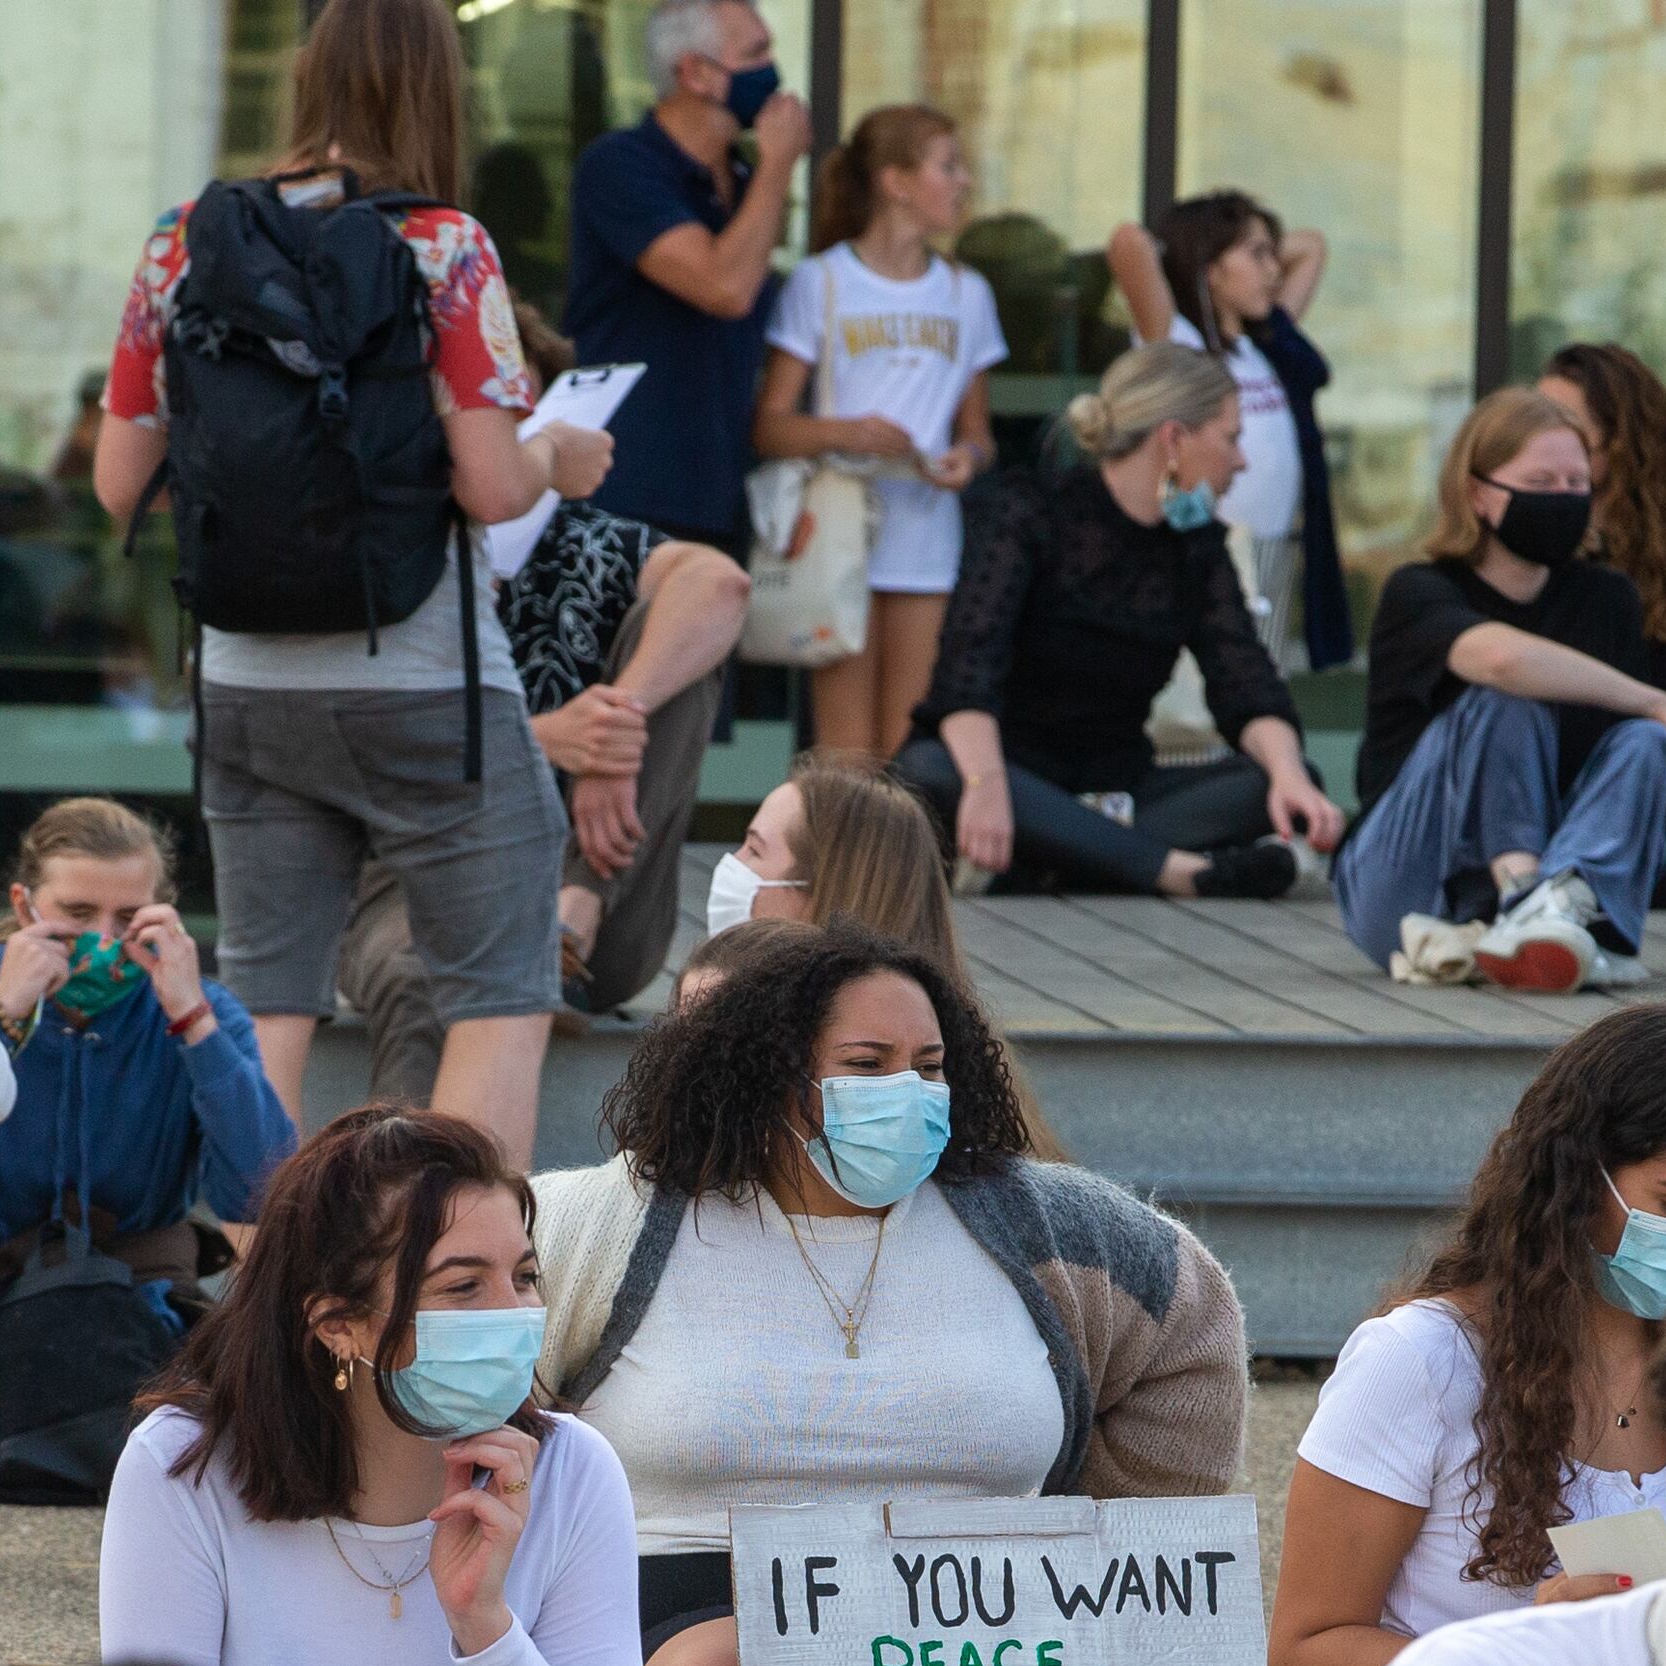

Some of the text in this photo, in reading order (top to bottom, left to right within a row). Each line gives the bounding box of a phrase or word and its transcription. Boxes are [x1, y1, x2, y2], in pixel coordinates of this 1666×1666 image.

[771, 1551, 1236, 1636] IF YOU WANT
